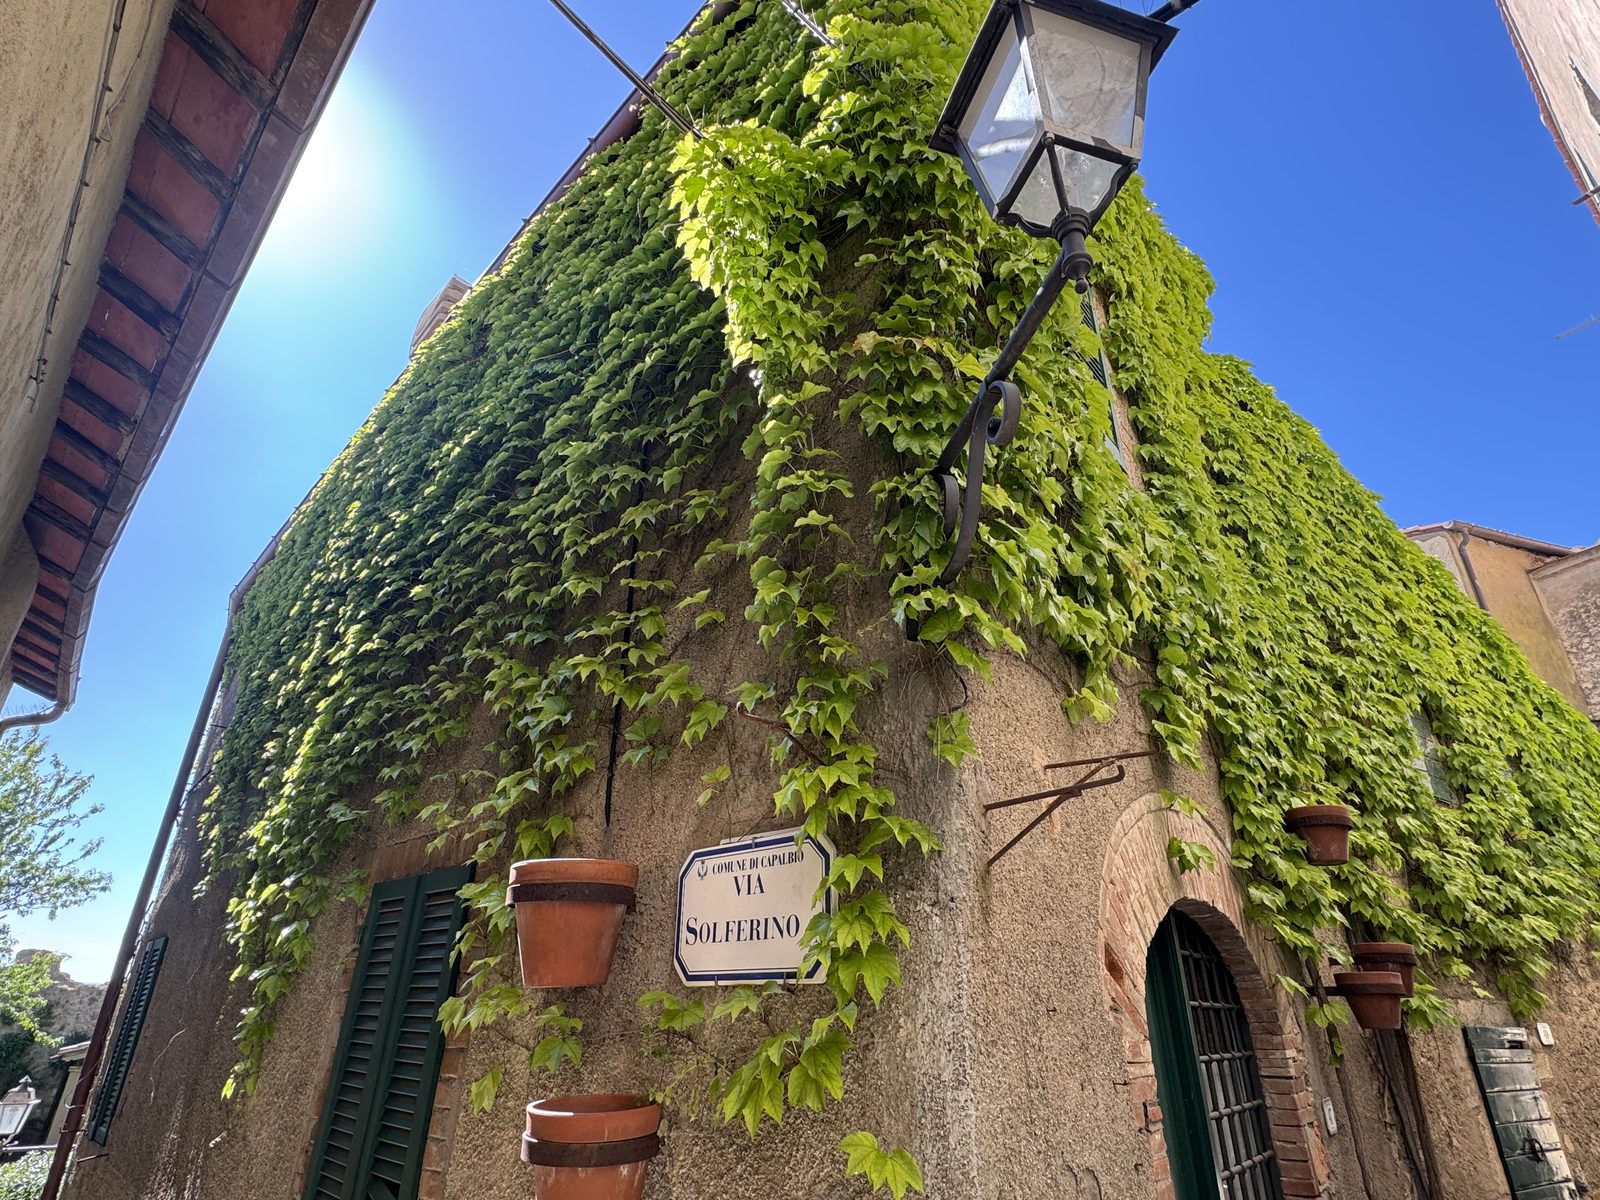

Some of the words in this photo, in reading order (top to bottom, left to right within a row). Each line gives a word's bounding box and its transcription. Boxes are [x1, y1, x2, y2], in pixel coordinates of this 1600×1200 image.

[712, 859, 747, 875] COMUNE
[749, 857, 759, 870] DI
[761, 850, 804, 868] CAPALBIO
[733, 873, 765, 897] VIA
[685, 913, 800, 946] SOLFERINO
